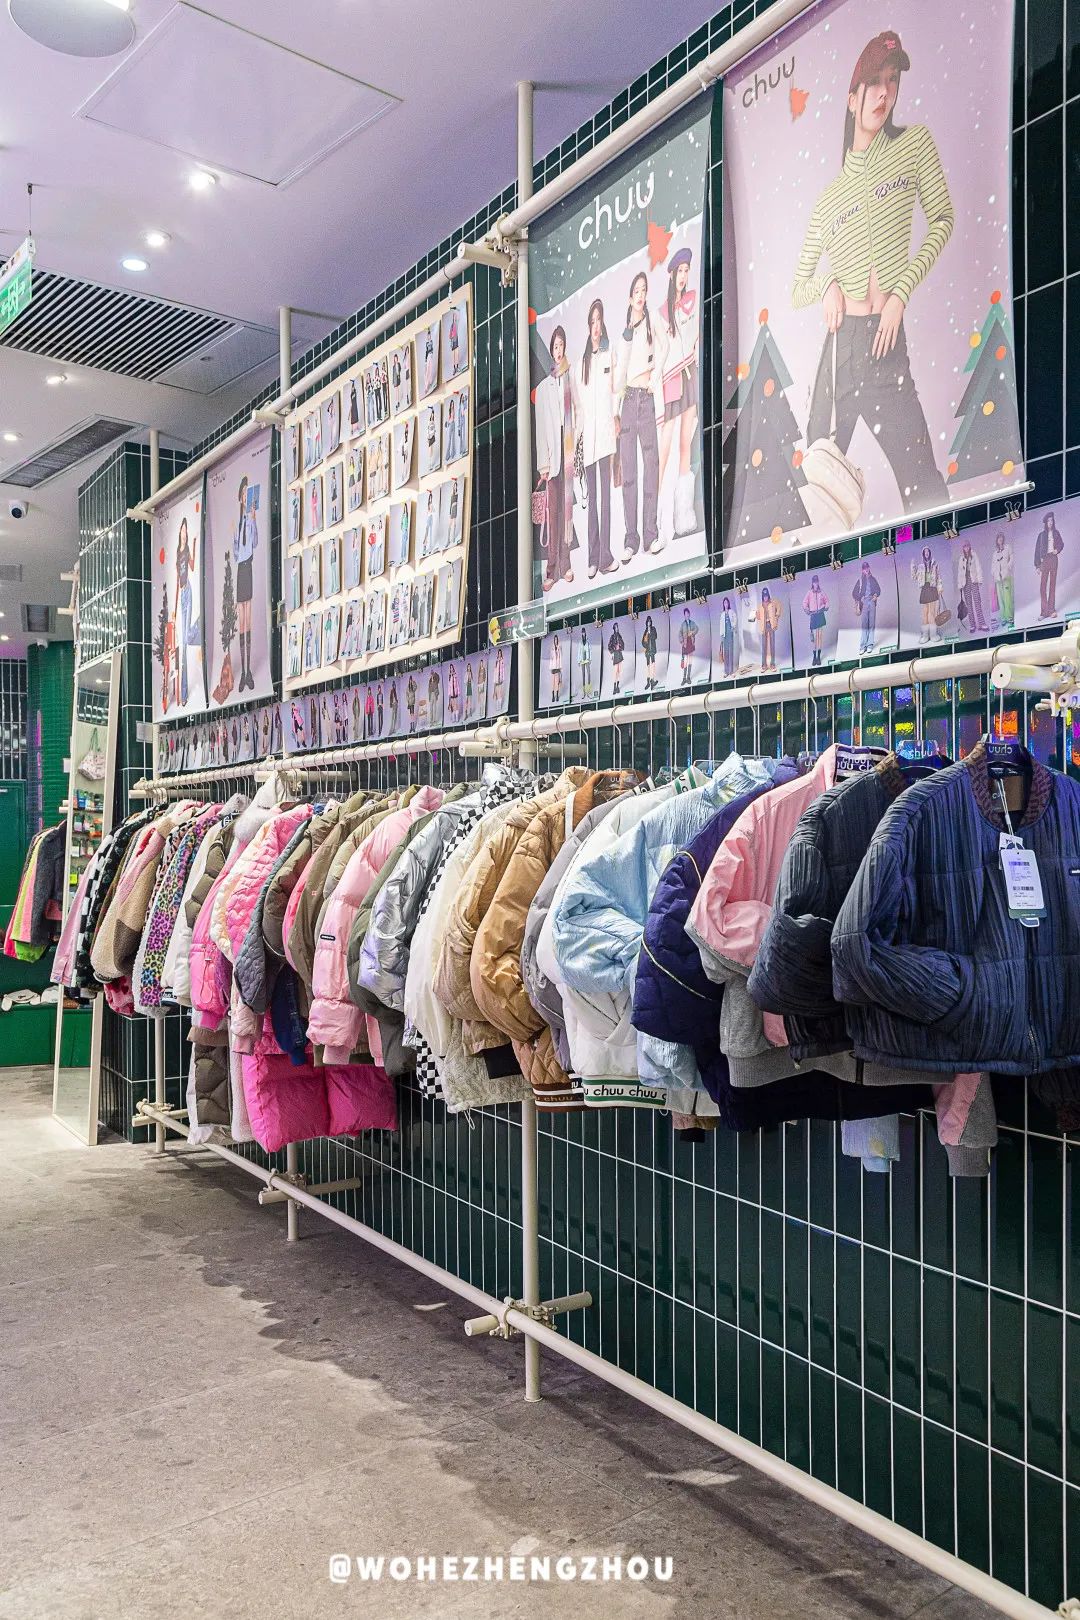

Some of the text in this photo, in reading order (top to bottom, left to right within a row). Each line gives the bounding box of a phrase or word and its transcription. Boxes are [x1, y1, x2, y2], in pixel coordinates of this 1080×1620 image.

[742, 55, 796, 108] chuu
[874, 176, 911, 200] Baby
[578, 171, 655, 250] chuu
[908, 748, 934, 760] chuu
[543, 1095, 574, 1103] chuu
[592, 1084, 624, 1097] chuu
[628, 1084, 658, 1099] chuu
